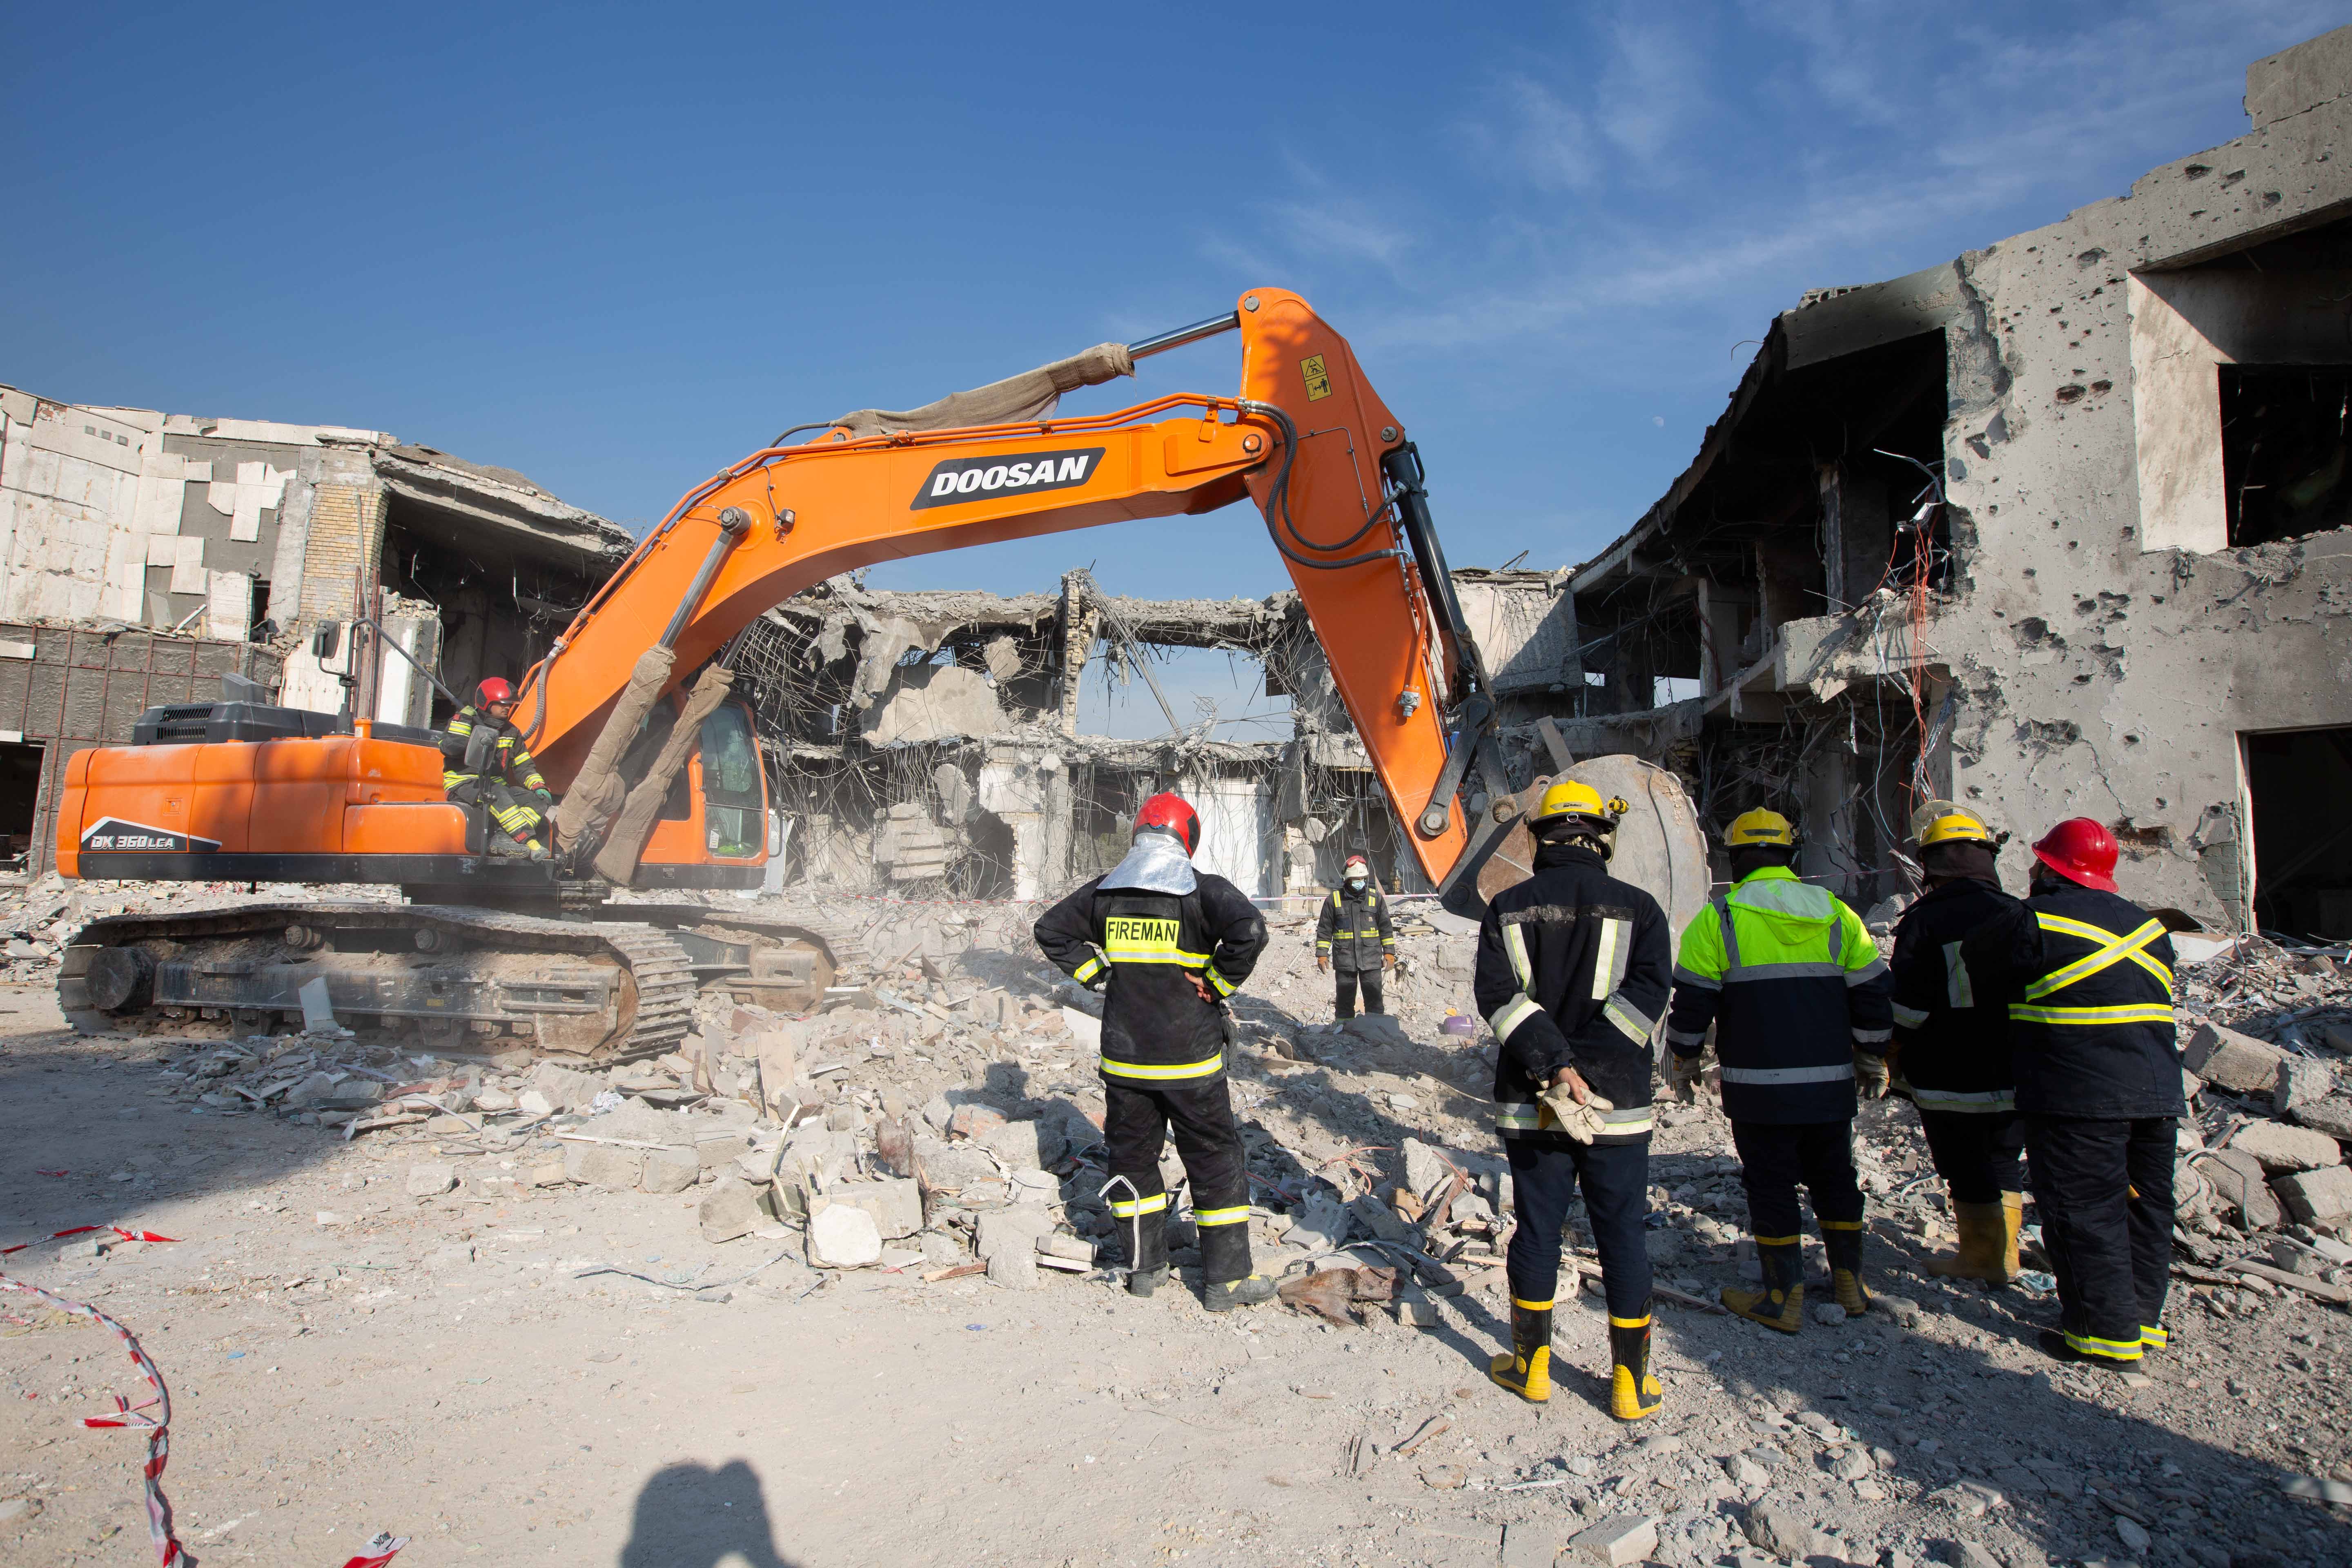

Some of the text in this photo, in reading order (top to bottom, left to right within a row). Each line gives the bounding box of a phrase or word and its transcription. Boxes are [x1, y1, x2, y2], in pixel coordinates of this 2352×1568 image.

[931, 455, 1089, 497] DOOSAN
[91, 836, 115, 849] DX
[1108, 922, 1176, 941] FIREMAN
